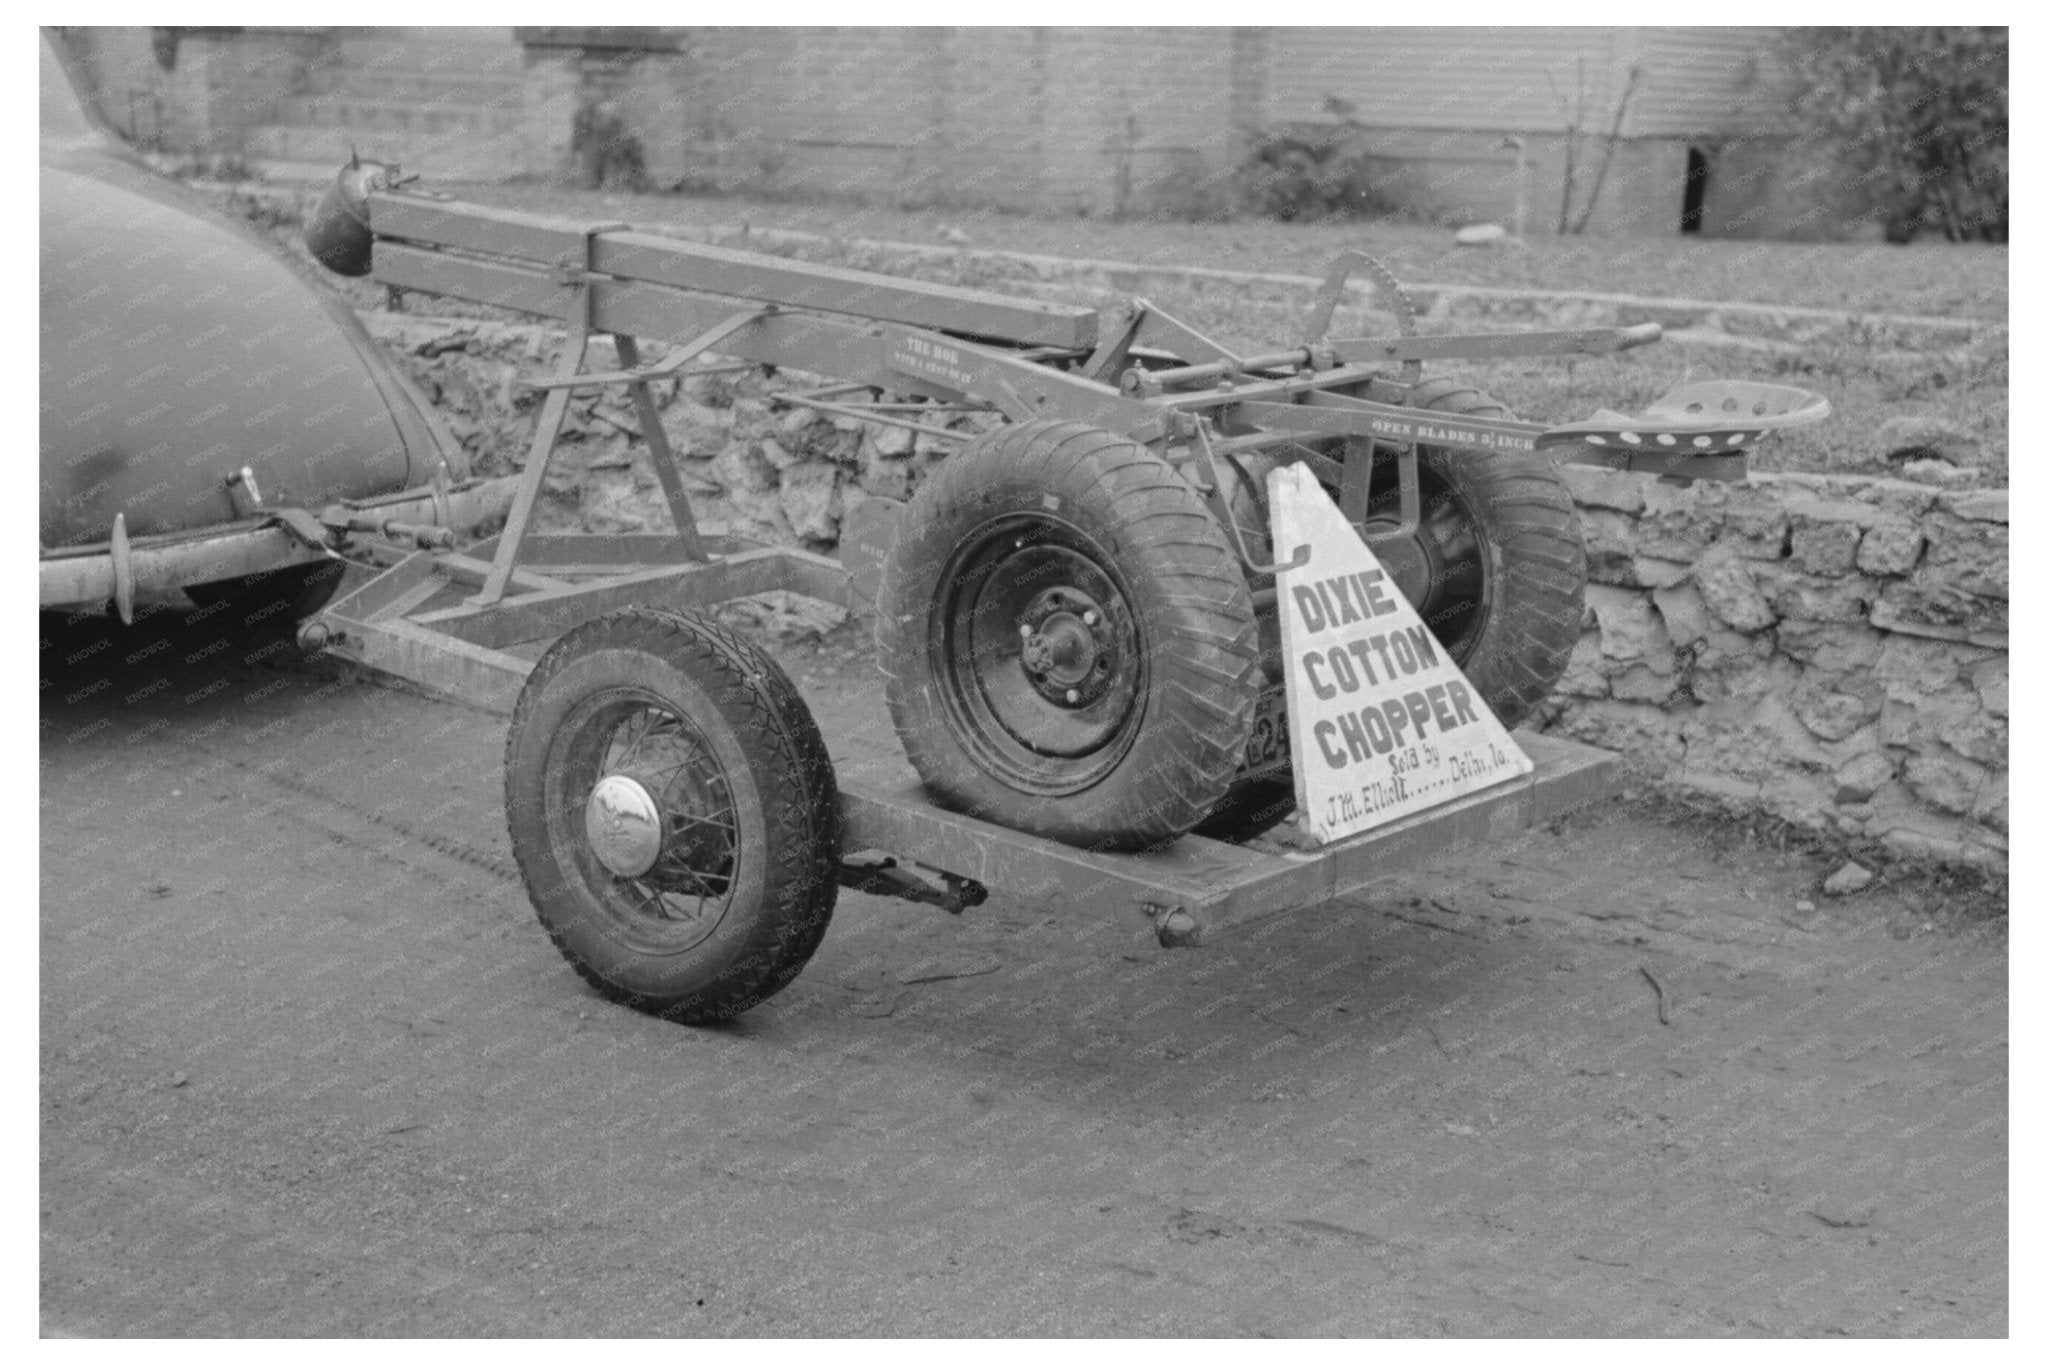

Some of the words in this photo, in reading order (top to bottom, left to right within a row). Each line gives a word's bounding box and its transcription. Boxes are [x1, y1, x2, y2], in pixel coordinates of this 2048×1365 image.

[1371, 421, 1411, 435] OPEN
[1417, 426, 1476, 443] BLADES
[1292, 568, 1398, 634] DIXIE
[1303, 624, 1439, 700] COTTON
[1313, 680, 1479, 769] CHOPPER
[1388, 748, 1420, 776] Sold
